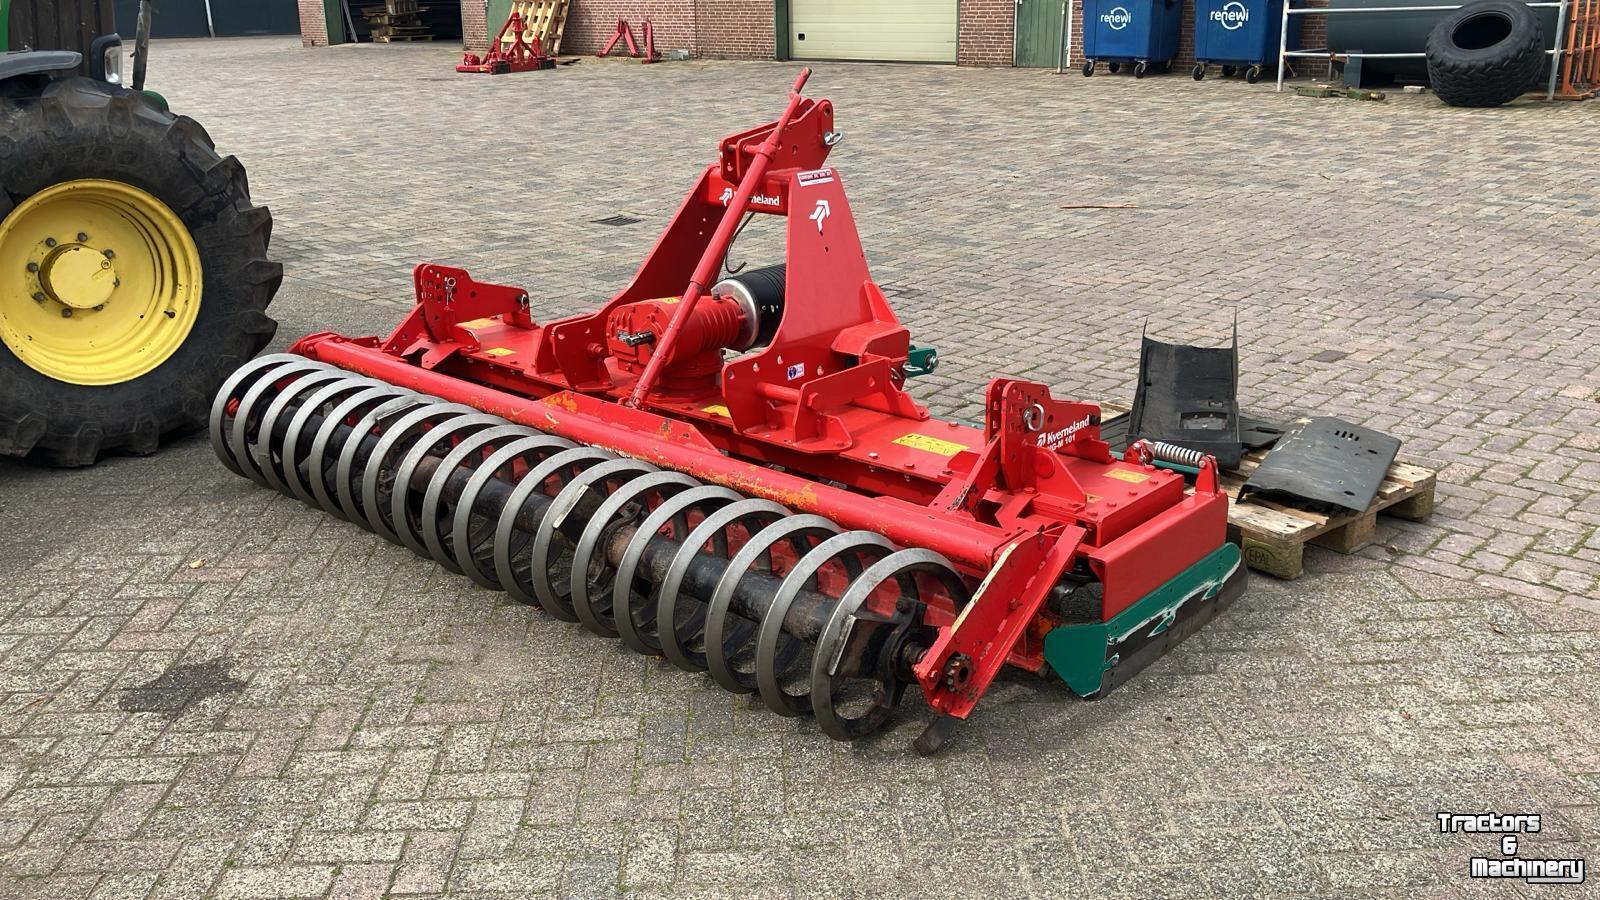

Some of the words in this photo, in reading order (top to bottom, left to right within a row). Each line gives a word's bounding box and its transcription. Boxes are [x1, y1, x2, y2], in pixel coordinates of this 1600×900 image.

[1100, 11, 1131, 23] renewi
[1210, 8, 1249, 22] renewi
[1047, 415, 1090, 445] Kverneland
[1064, 433, 1076, 444] 101
